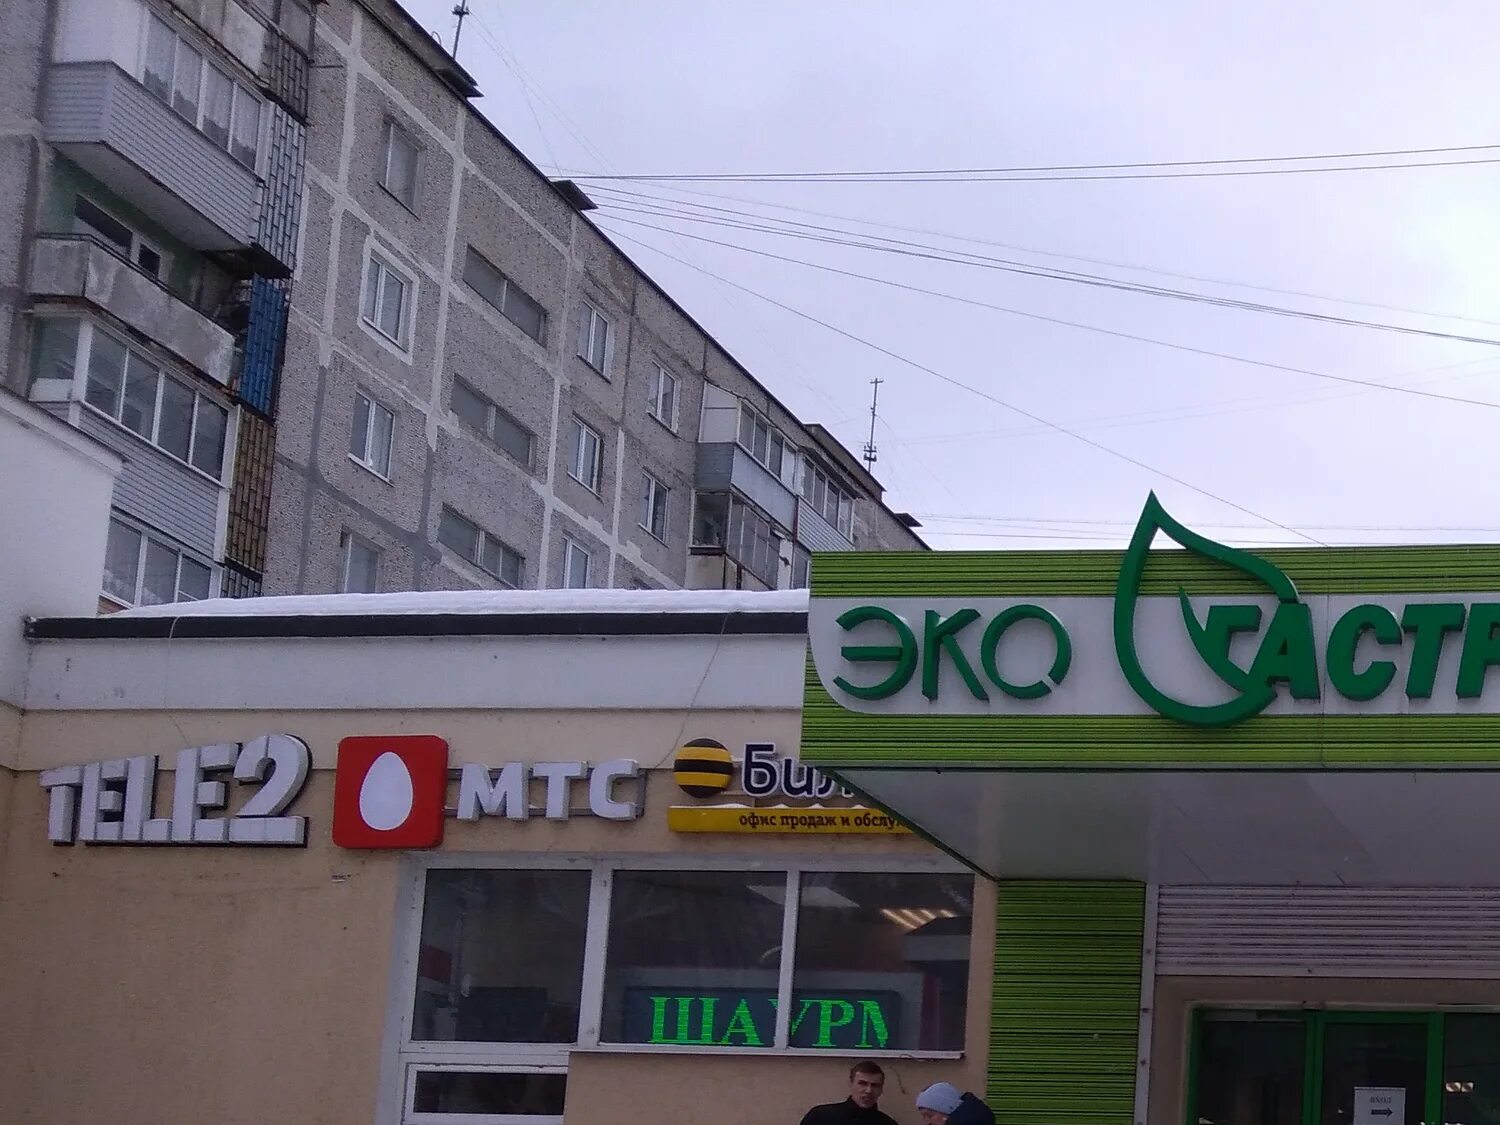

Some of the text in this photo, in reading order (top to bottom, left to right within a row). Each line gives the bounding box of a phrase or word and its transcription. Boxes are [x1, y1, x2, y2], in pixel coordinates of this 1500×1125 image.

[834, 604, 1072, 701] ЭКО
[39, 733, 312, 847] TELE2
[455, 759, 646, 820] МТС
[739, 813, 777, 829] офис
[780, 813, 836, 829] продаж
[841, 815, 850, 826] и
